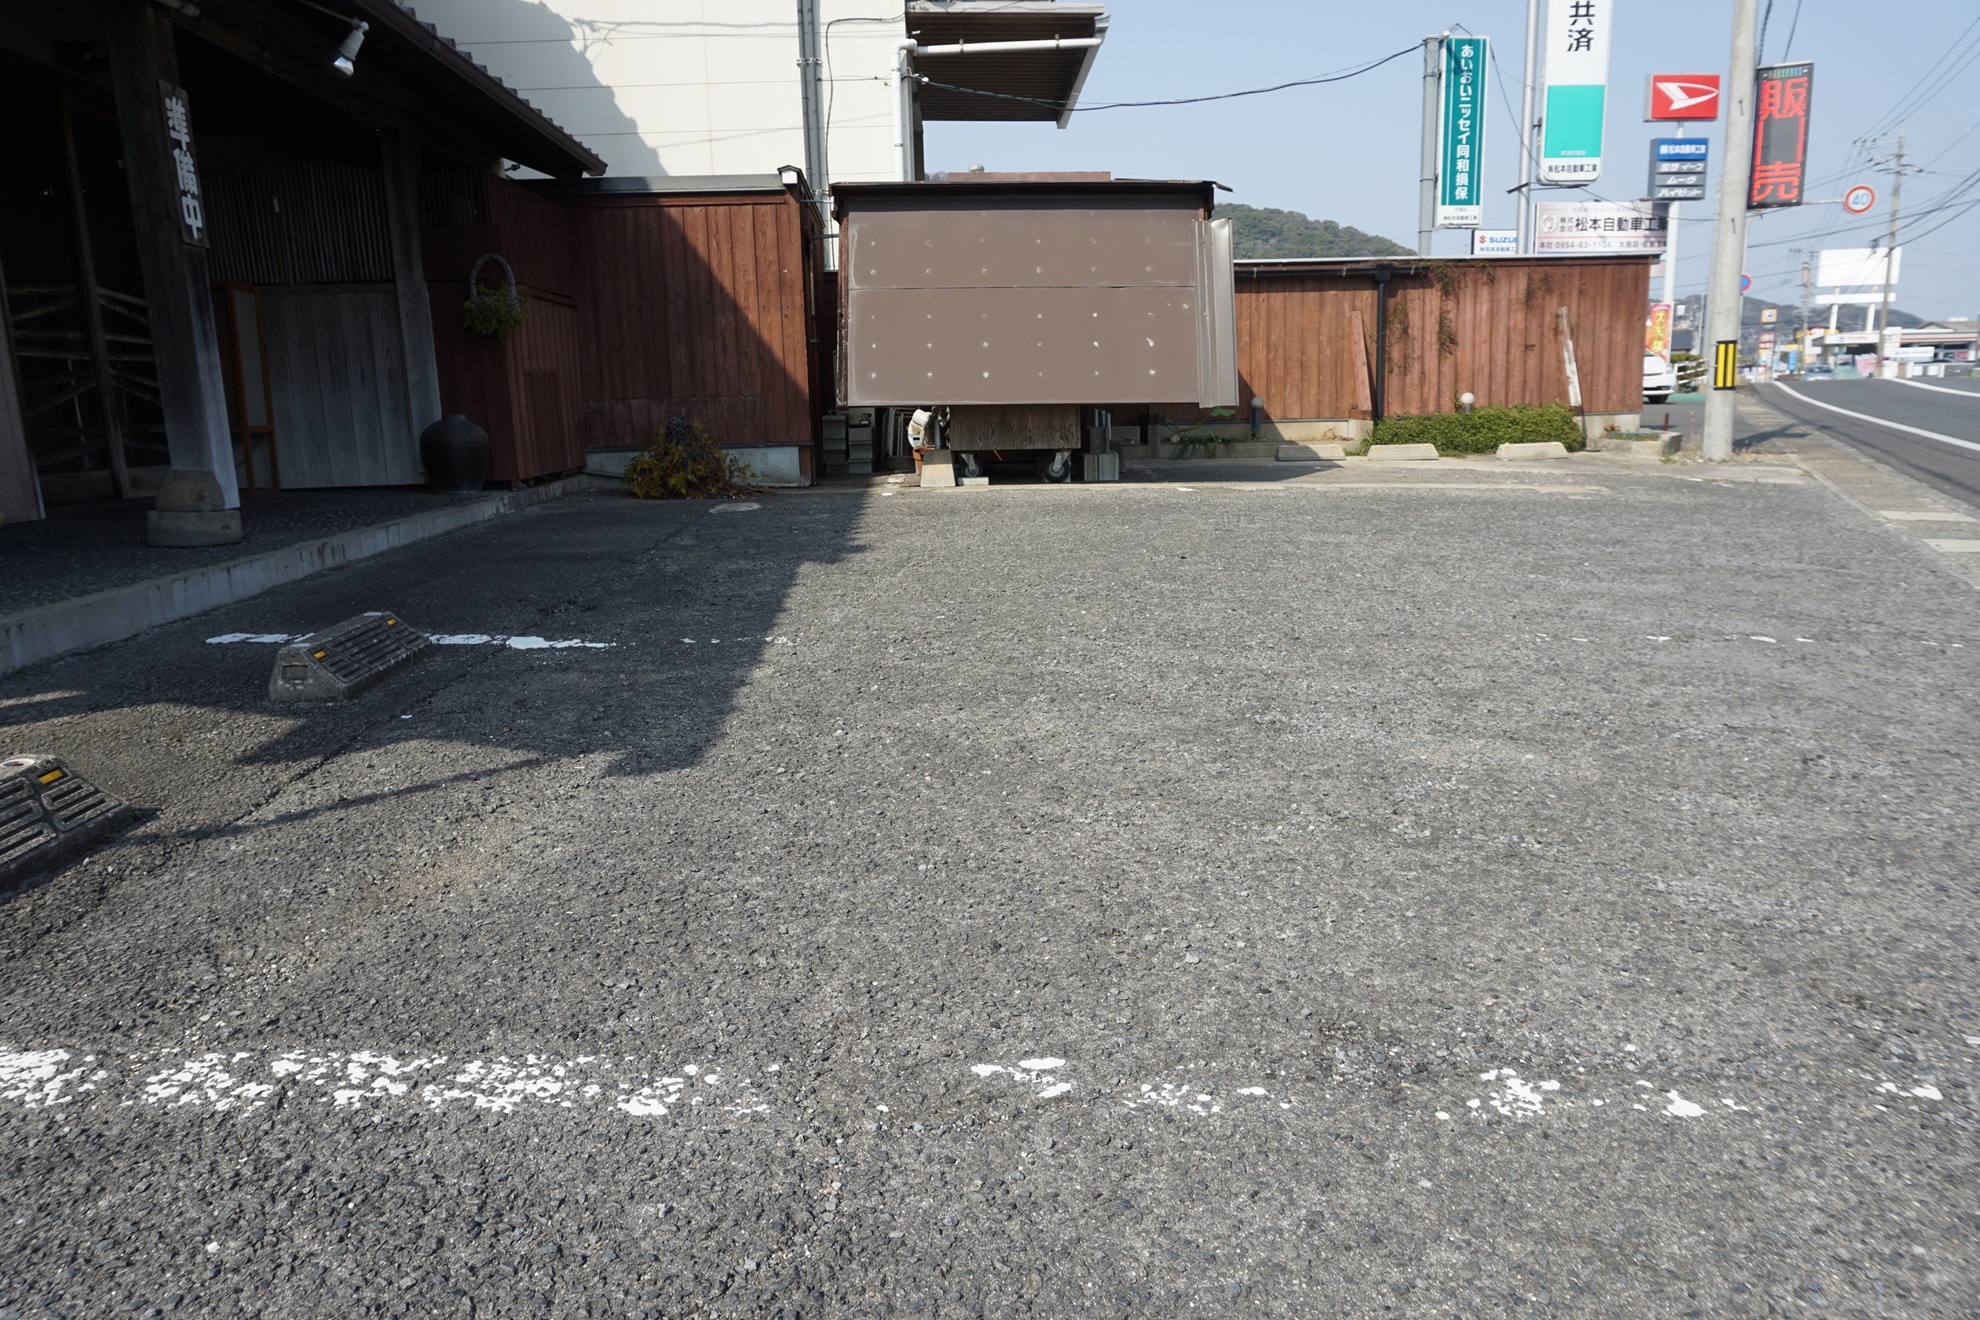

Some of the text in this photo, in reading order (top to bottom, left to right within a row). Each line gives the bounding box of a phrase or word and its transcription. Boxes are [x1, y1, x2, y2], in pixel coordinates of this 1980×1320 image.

[1567, 0, 1595, 52] 共済
[165, 96, 203, 240] 準備中
[1455, 44, 1474, 200] あいおいニッセイ同和損保
[1852, 193, 1870, 205] 40
